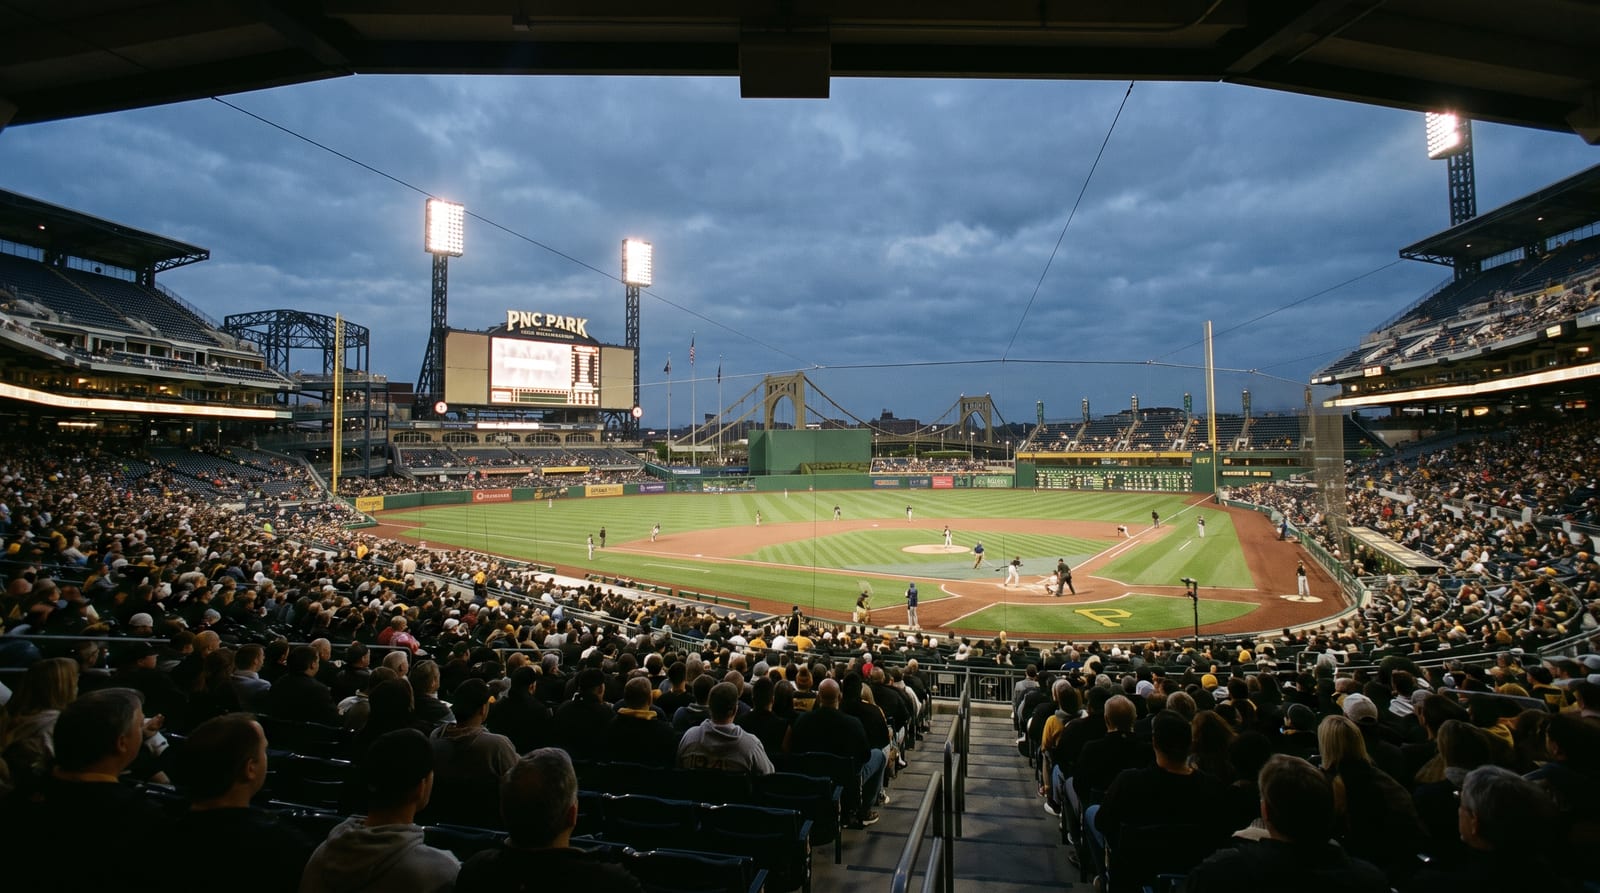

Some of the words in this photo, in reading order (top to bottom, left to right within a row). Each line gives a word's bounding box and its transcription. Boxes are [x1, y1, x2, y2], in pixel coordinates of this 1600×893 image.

[507, 310, 542, 331] PNC
[546, 313, 589, 339] PARK
[1074, 608, 1132, 627] P
